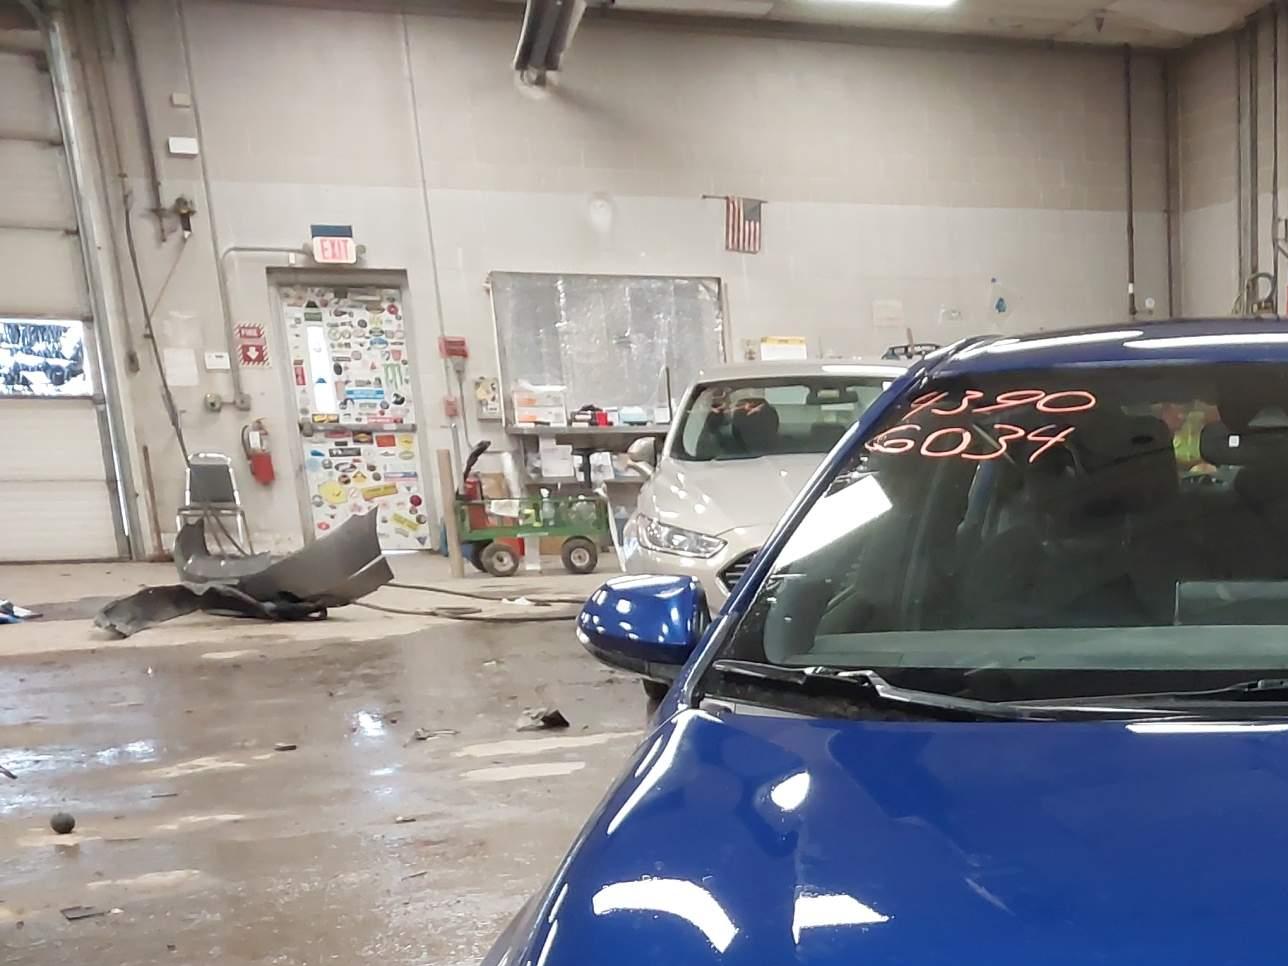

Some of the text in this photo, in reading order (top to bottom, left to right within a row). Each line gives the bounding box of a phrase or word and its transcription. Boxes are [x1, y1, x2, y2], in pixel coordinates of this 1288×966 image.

[319, 239, 349, 260] EXIT
[901, 389, 1096, 421] 4390
[864, 424, 1076, 464] 6034
